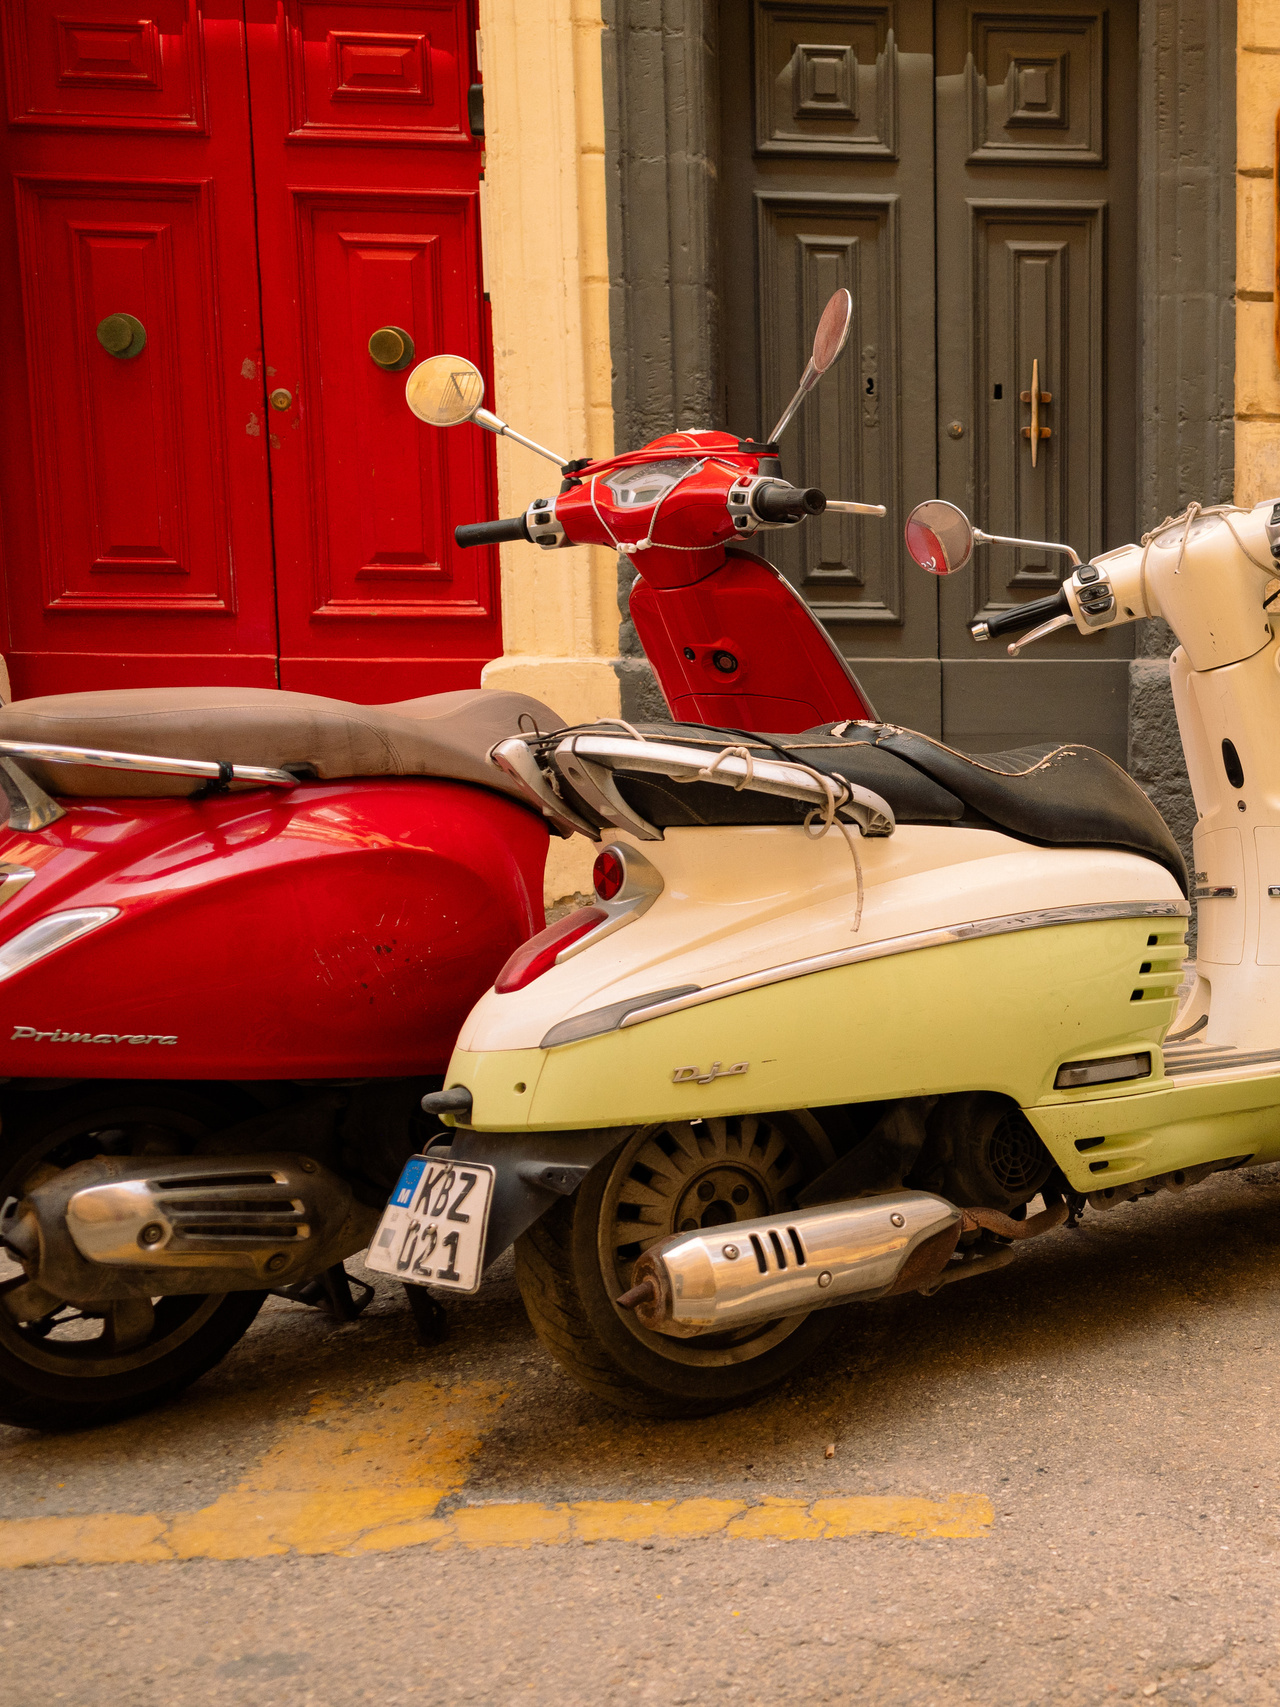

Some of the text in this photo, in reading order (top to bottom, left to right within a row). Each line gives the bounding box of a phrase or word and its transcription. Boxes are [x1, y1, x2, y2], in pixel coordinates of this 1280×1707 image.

[10, 1025, 178, 1045] Primavera
[672, 1061, 749, 1085] Dja
[397, 1188, 411, 1203] M
[413, 1166, 478, 1223] KBZ
[396, 1222, 461, 1282] 021
